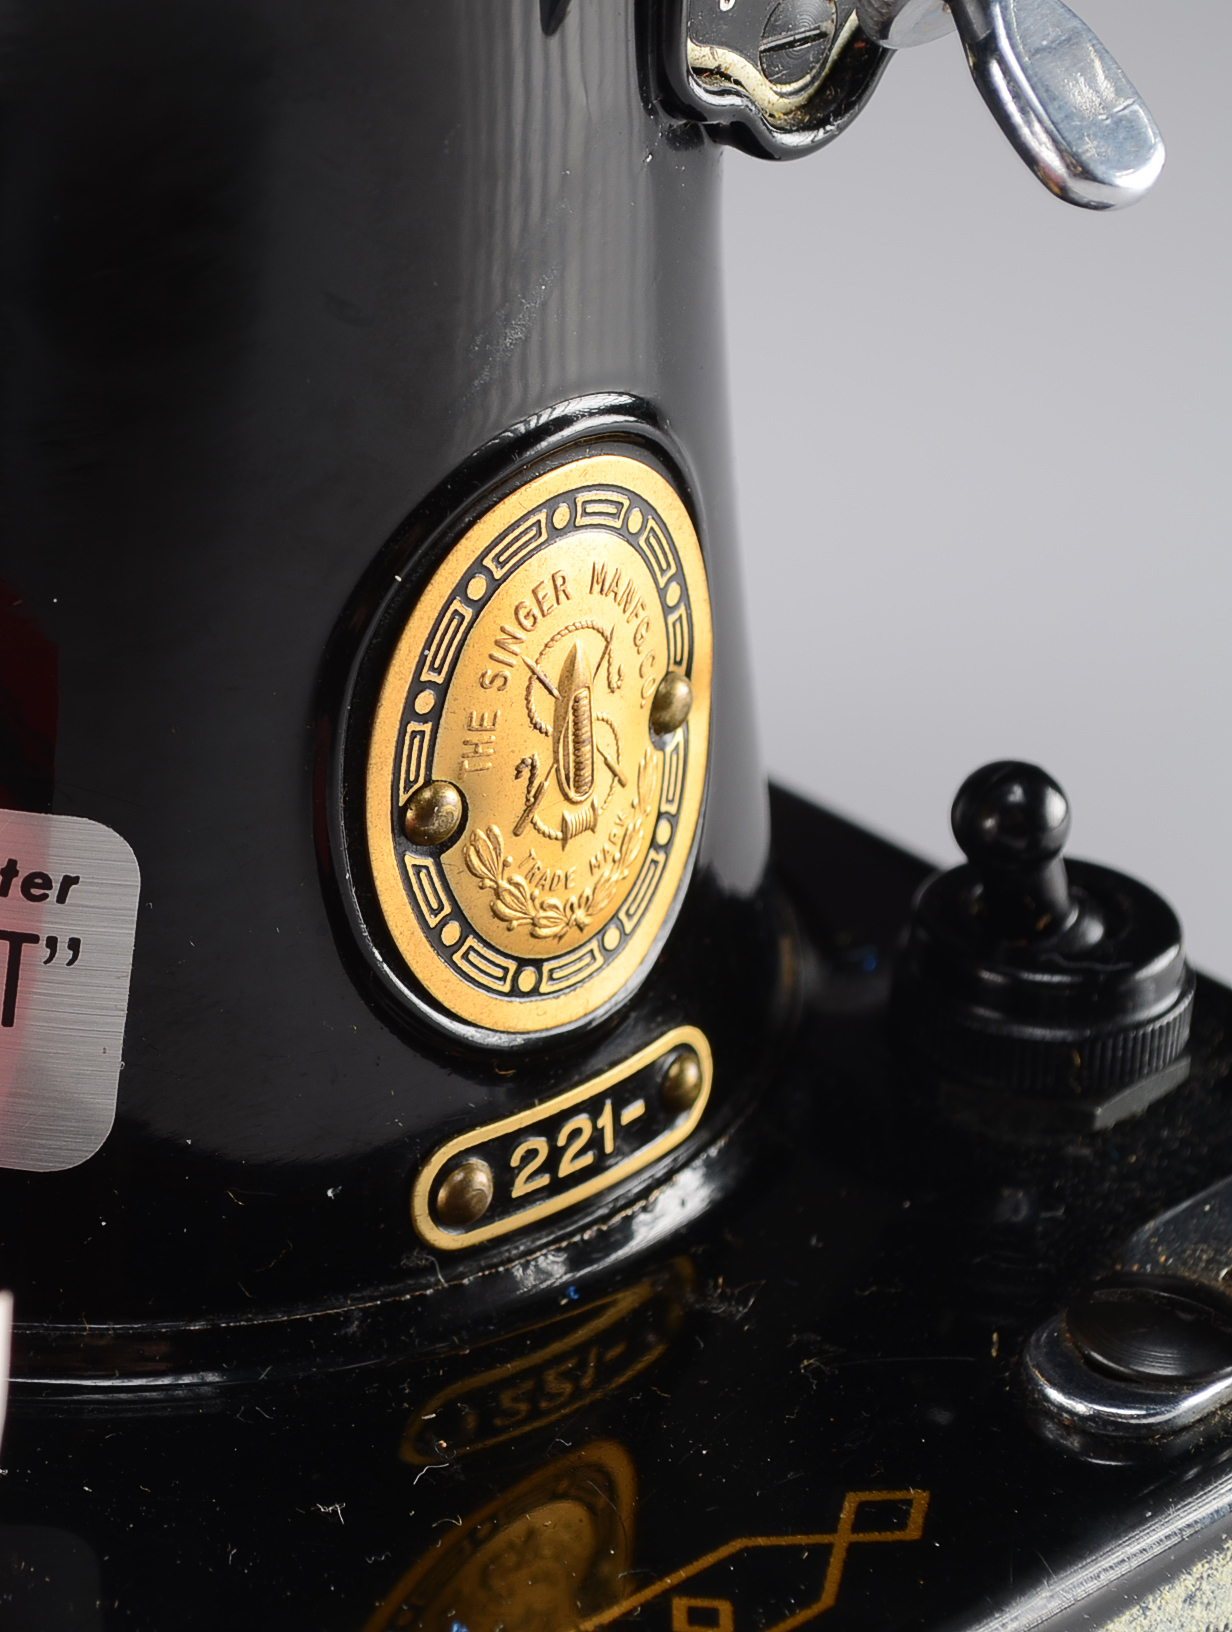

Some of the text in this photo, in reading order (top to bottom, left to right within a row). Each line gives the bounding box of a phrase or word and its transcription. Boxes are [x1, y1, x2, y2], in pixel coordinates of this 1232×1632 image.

[479, 569, 572, 691] SINGER
[458, 710, 501, 780] THE
[518, 811, 628, 891] TRADE MARK
